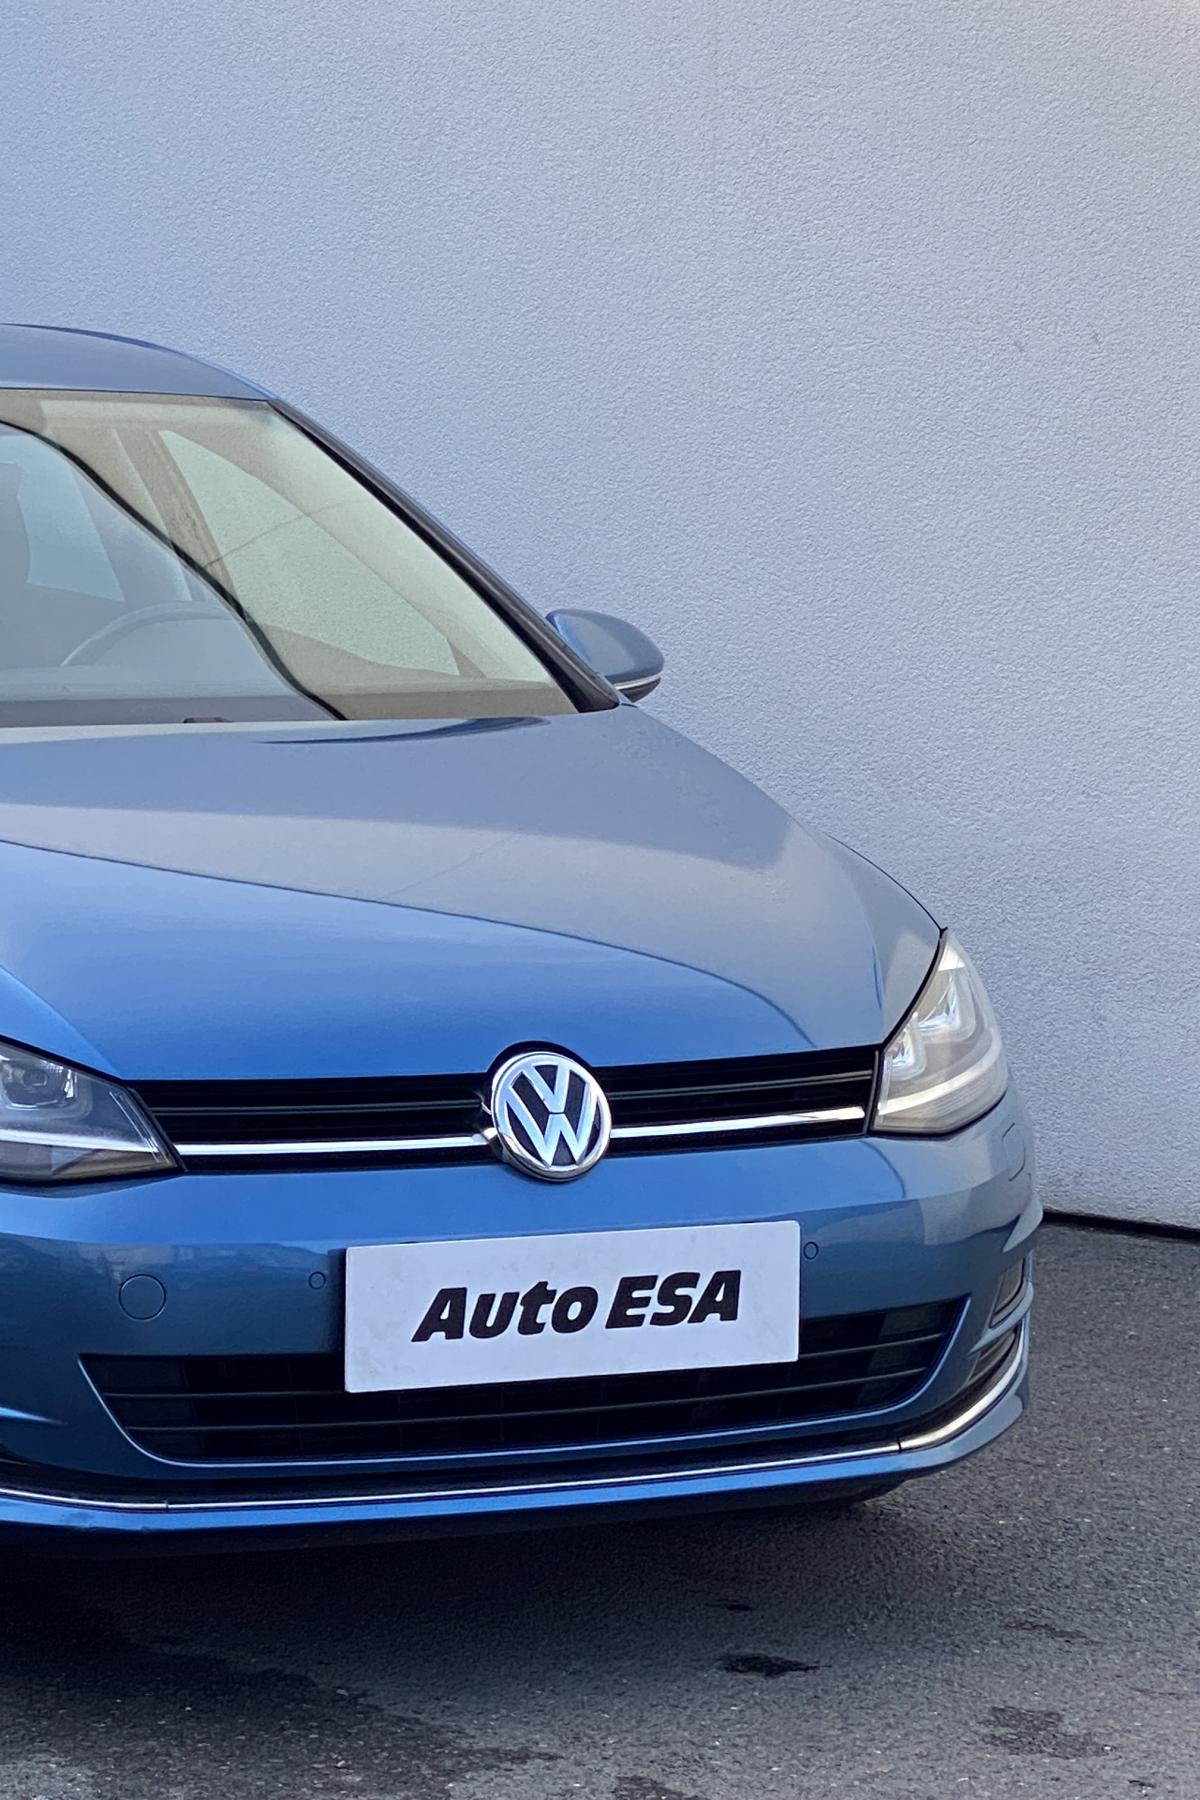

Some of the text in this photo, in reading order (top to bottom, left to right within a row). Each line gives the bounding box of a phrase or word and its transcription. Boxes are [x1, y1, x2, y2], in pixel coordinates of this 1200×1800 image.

[498, 1059, 604, 1172] VW
[411, 1270, 741, 1342] Auto ESA
